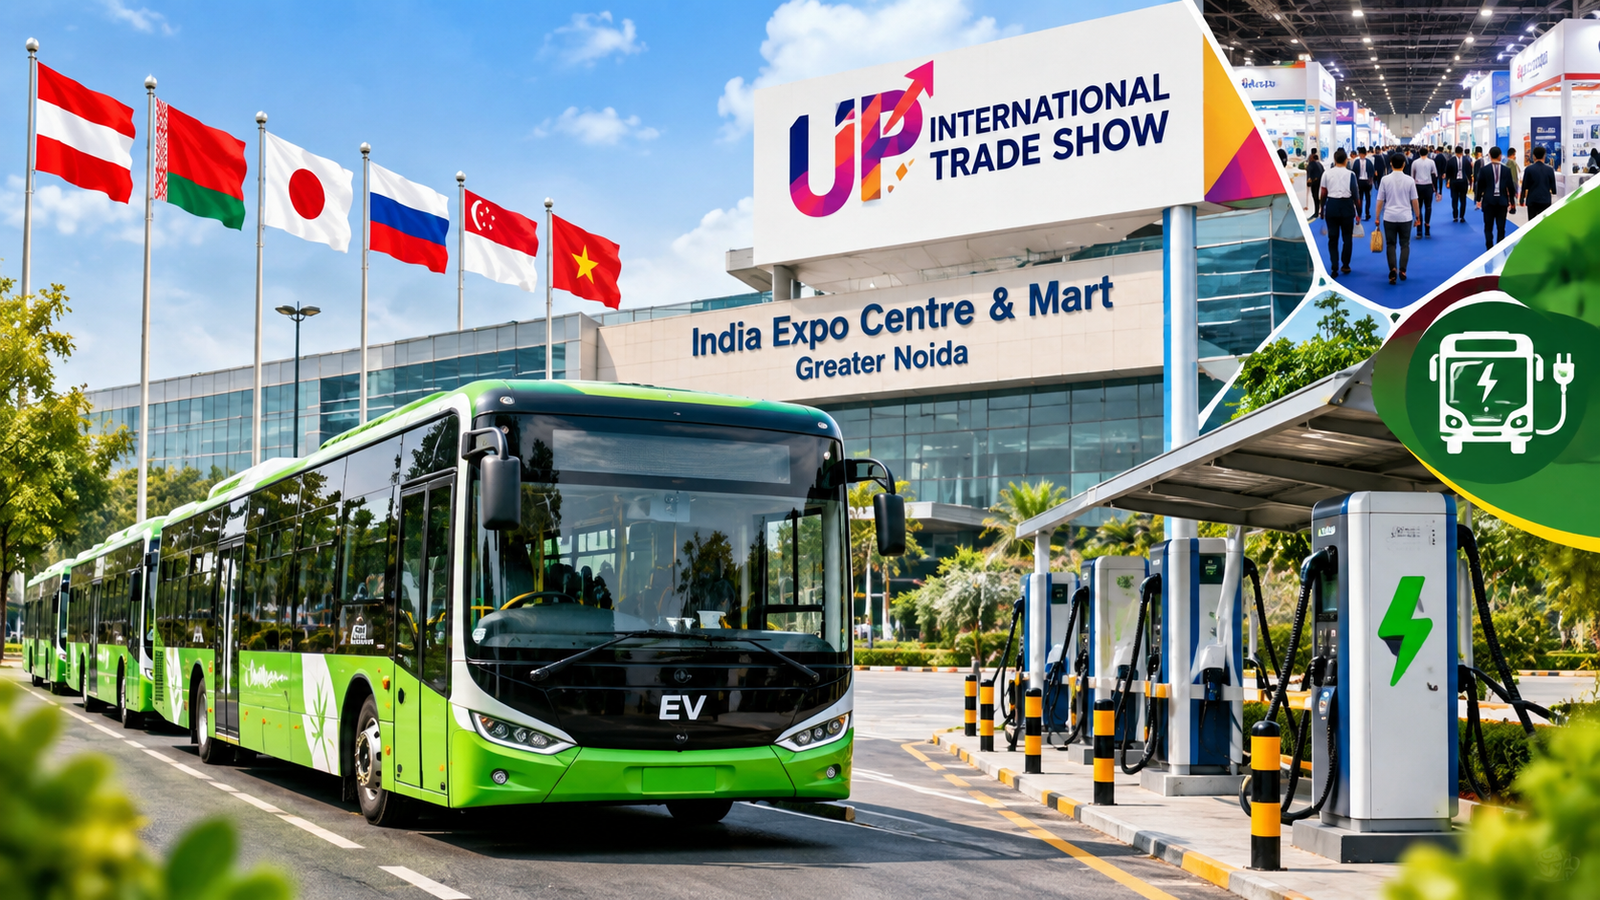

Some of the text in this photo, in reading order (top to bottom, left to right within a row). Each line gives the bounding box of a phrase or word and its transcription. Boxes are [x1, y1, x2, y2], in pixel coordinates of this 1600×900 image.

[930, 73, 1170, 143] INTERNATIONAL
[789, 90, 923, 218] UP
[930, 110, 1170, 181] TRADE SHOW
[692, 275, 1114, 357] India Expo Centre & Mart
[795, 340, 969, 381] Greater Noida
[659, 694, 707, 720] EV
